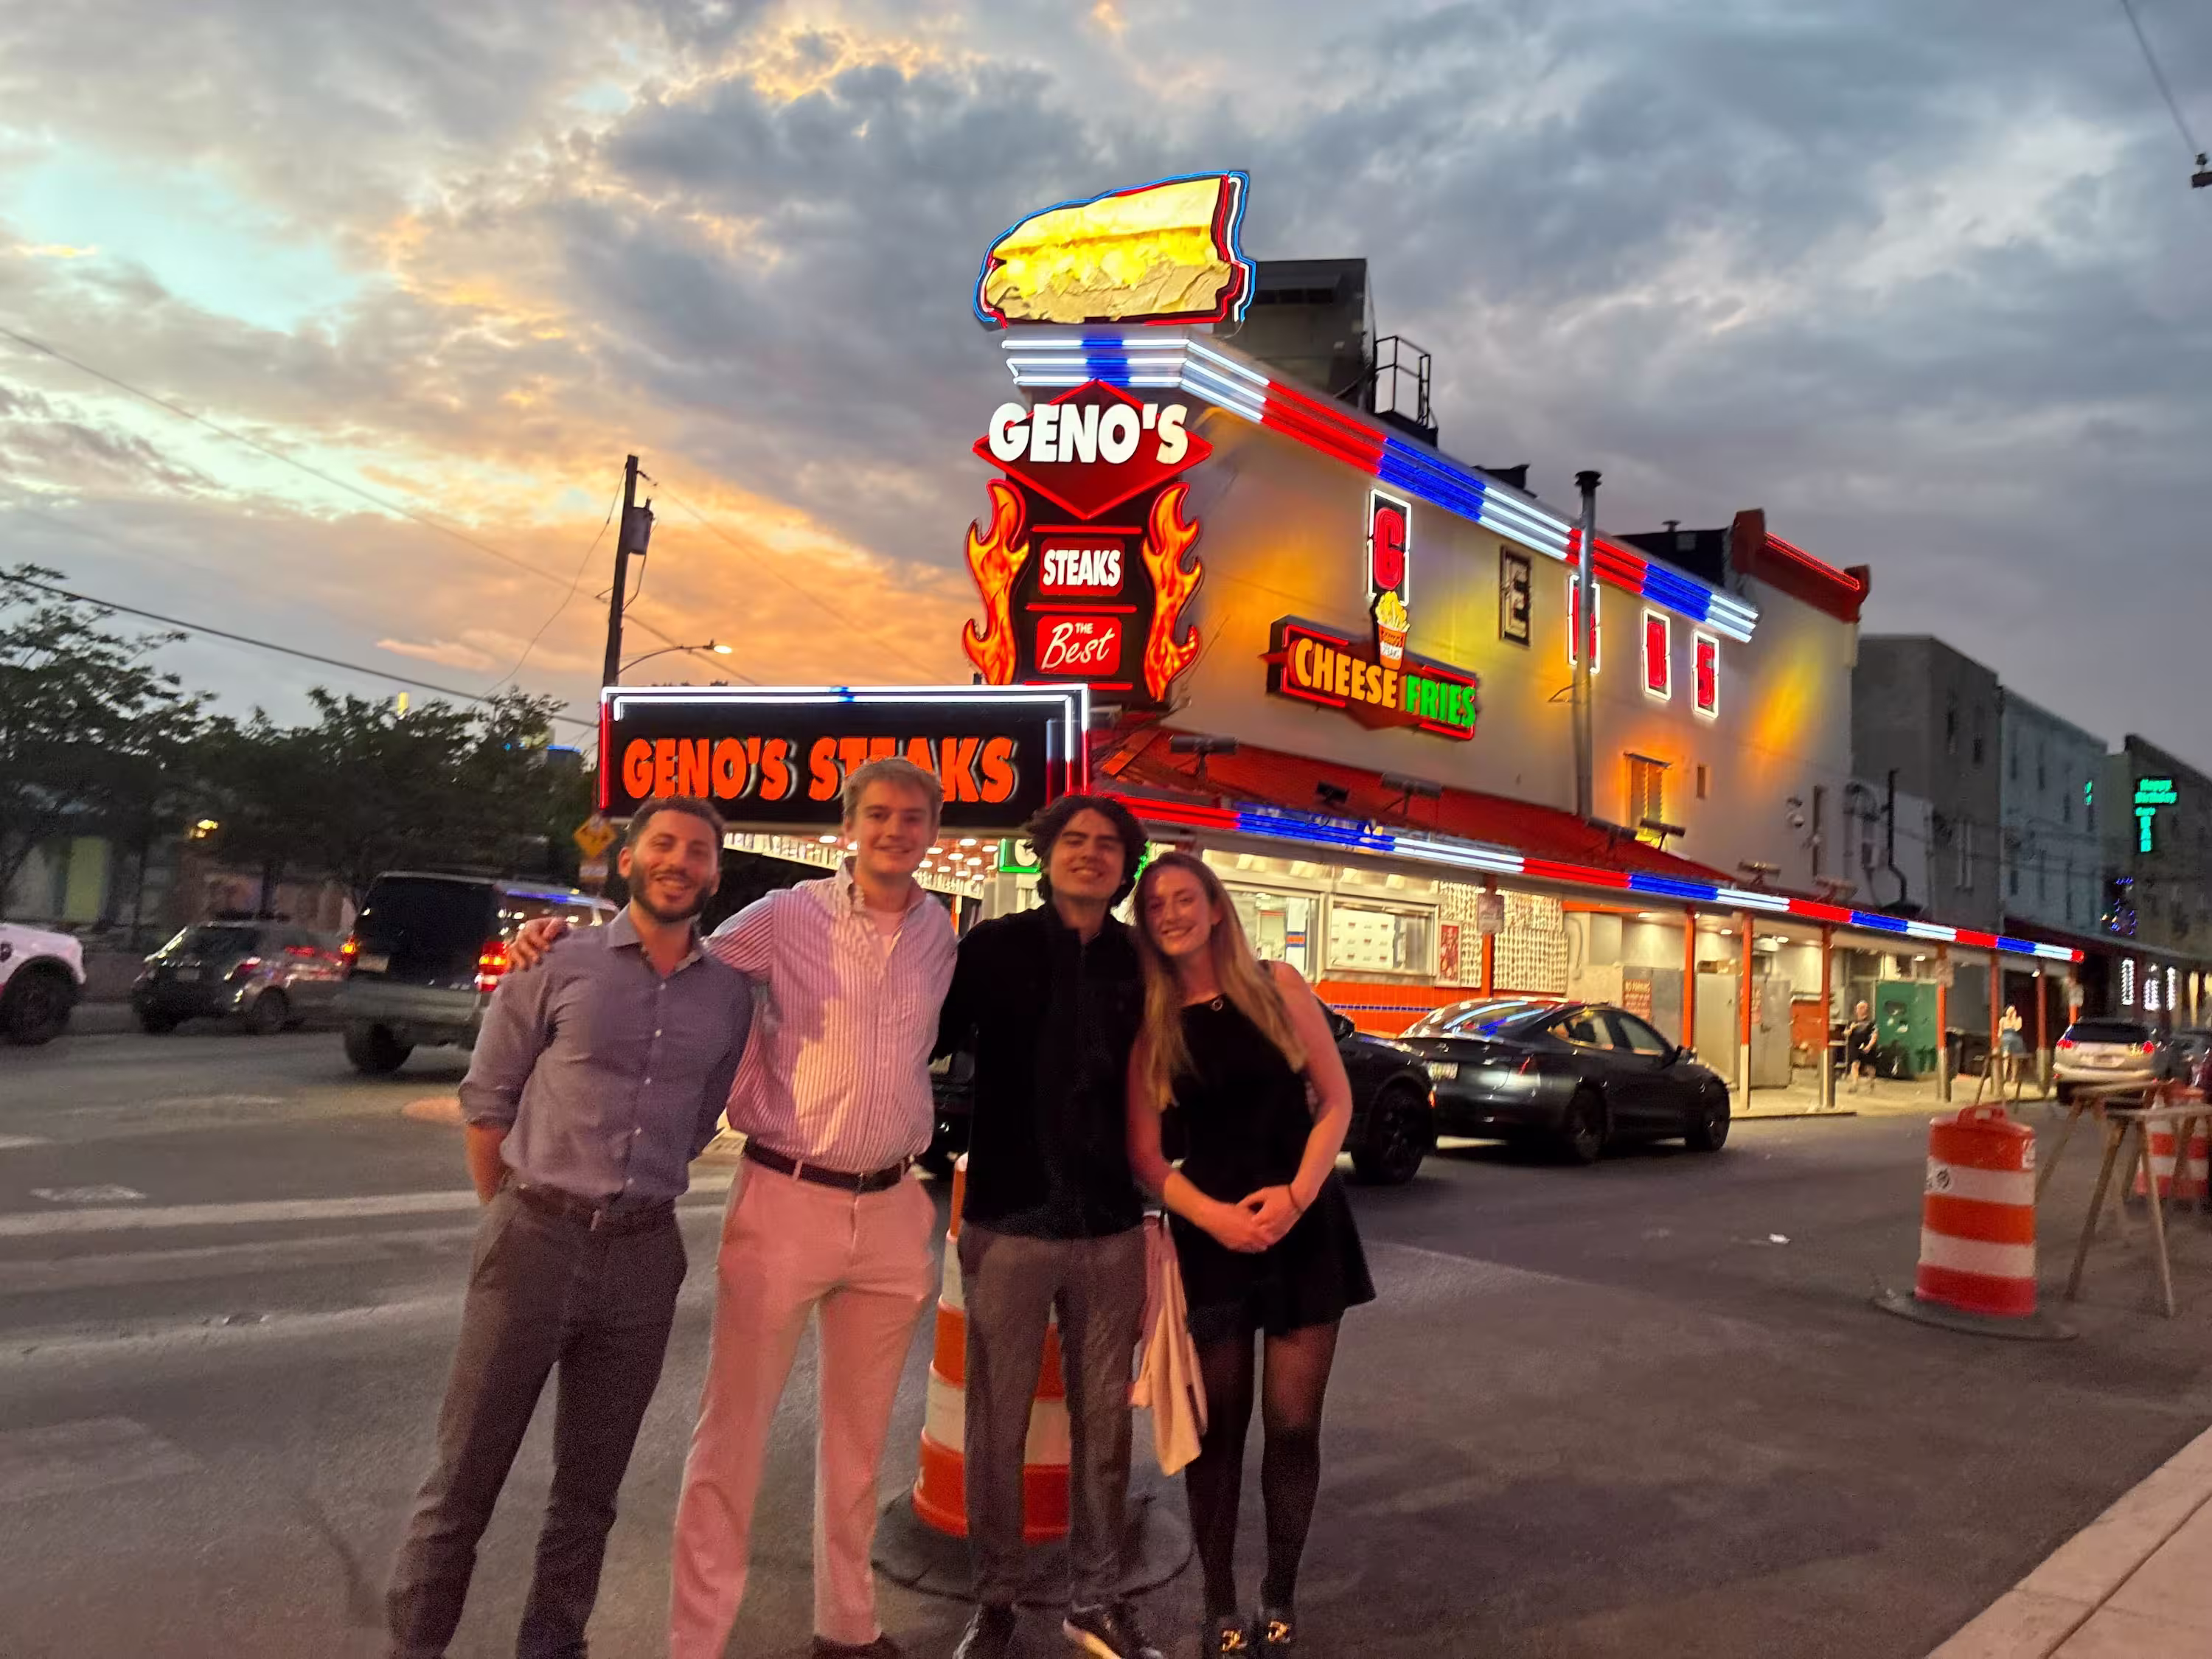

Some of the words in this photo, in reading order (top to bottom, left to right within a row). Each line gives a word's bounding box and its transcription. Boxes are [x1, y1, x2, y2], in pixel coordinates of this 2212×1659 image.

[988, 402, 1189, 465] GENO'S
[1042, 549, 1121, 588] STEAKS
[1040, 622, 1116, 672] Best
[1075, 622, 1093, 635] THE
[1295, 638, 1398, 709] CHEESE
[1406, 674, 1475, 728] FRIES
[621, 737, 788, 801] GENO'S
